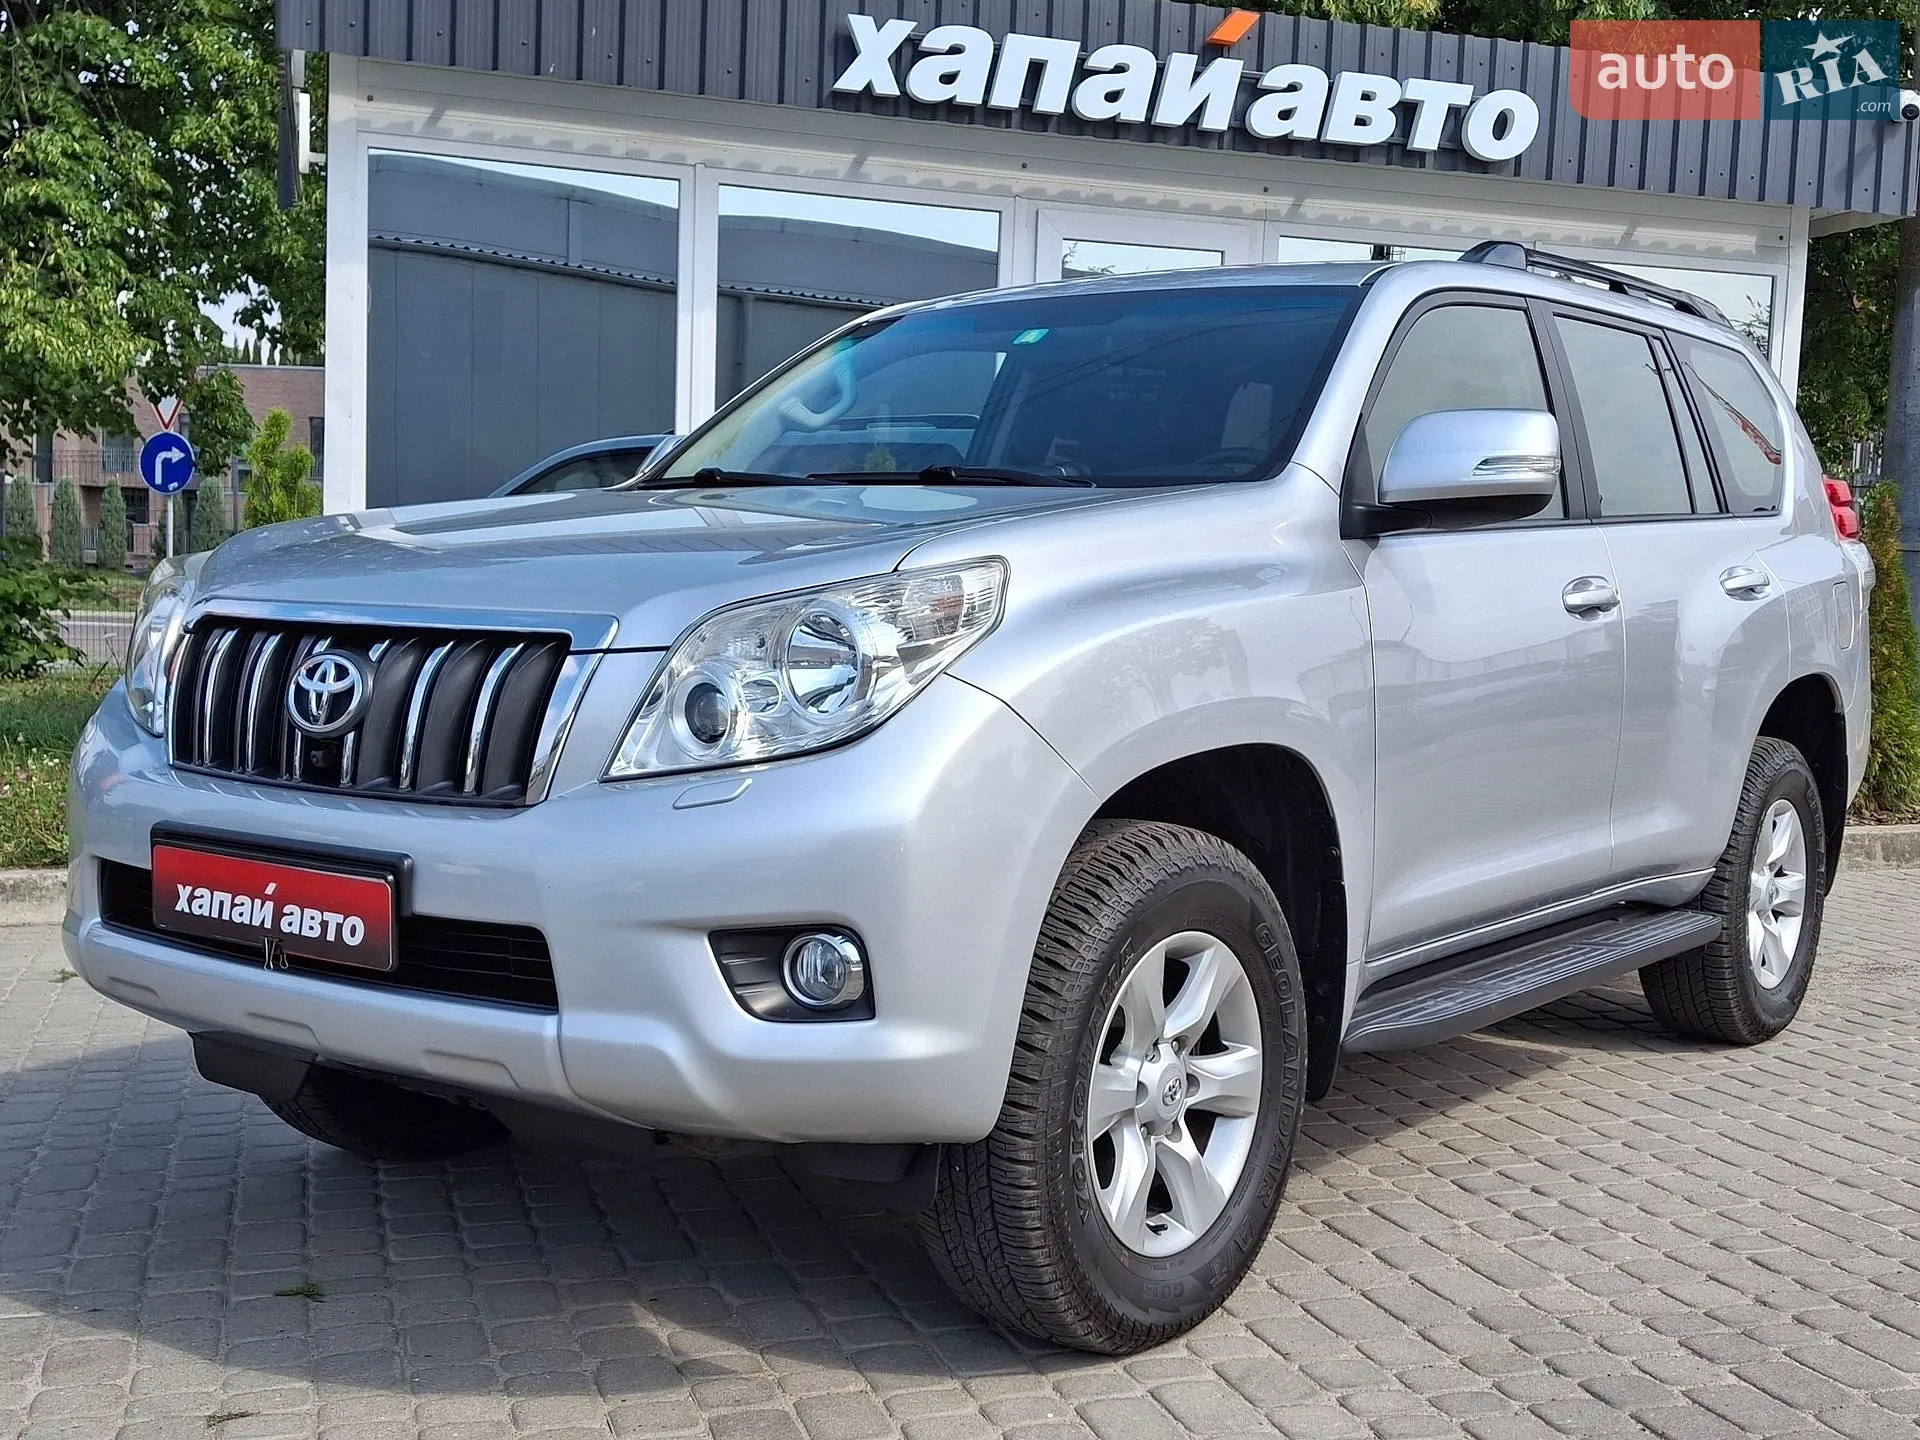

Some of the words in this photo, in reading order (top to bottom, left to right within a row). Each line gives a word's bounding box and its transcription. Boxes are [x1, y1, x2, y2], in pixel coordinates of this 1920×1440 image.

[1245, 64, 1539, 161] авто
[279, 904, 365, 946] авто
[1253, 920, 1301, 1209] GEOLANDAR
